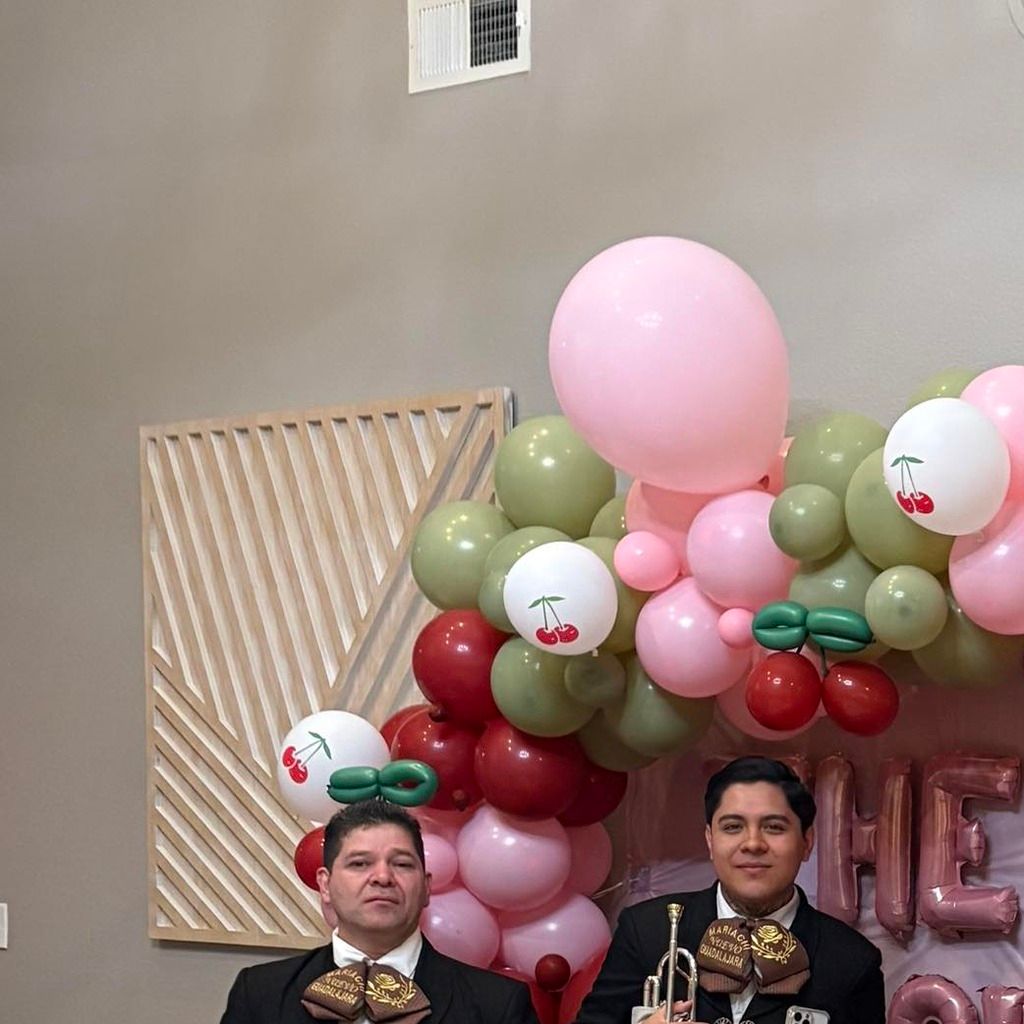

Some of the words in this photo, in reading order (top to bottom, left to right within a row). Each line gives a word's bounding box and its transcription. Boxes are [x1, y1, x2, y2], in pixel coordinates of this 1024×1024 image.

[703, 751, 1022, 942] HE
[709, 925, 751, 951] MARIACHI
[709, 936, 743, 955] NUEVO
[700, 943, 744, 969] GUADALAJARA
